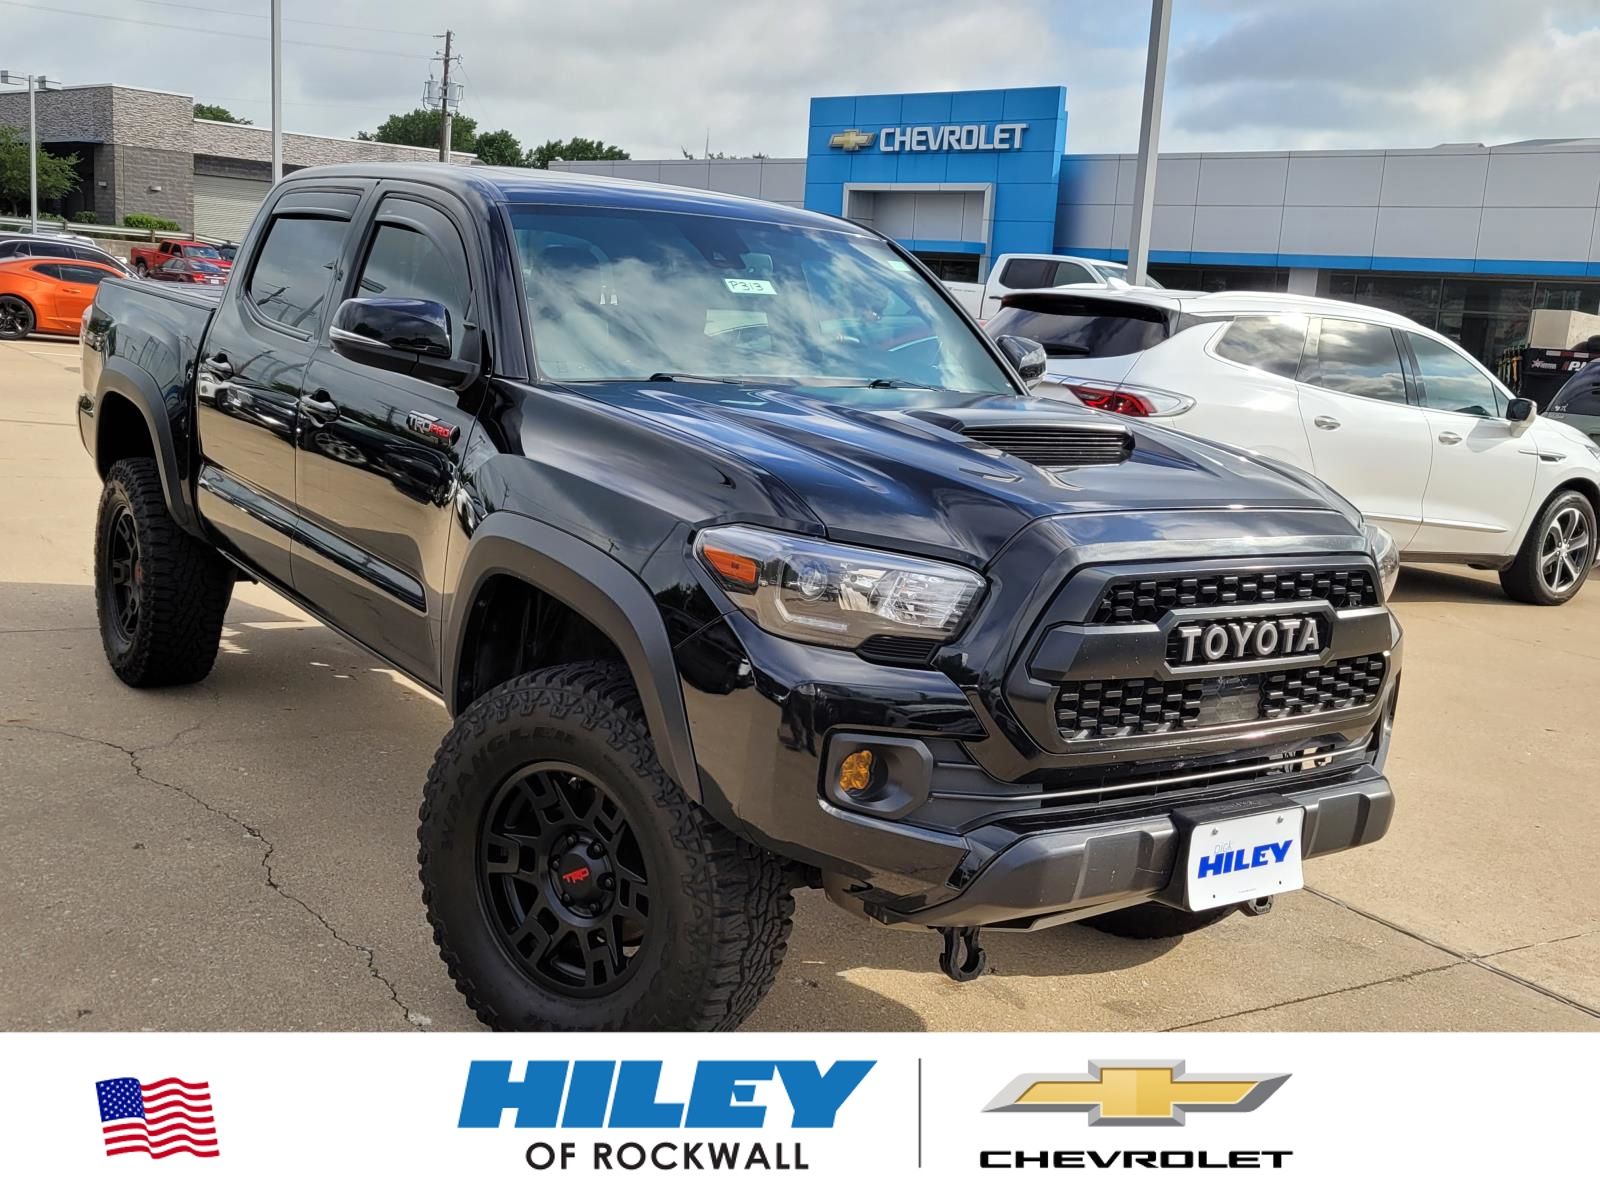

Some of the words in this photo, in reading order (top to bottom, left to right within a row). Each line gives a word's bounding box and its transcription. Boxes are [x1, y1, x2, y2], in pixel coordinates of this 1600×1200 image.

[879, 123, 1028, 152] CHEVROLET
[728, 280, 764, 291] P313
[430, 423, 449, 437] PRO
[1178, 617, 1320, 662] TOYOTA
[1197, 839, 1293, 879] HILEY
[563, 867, 590, 884] TRD
